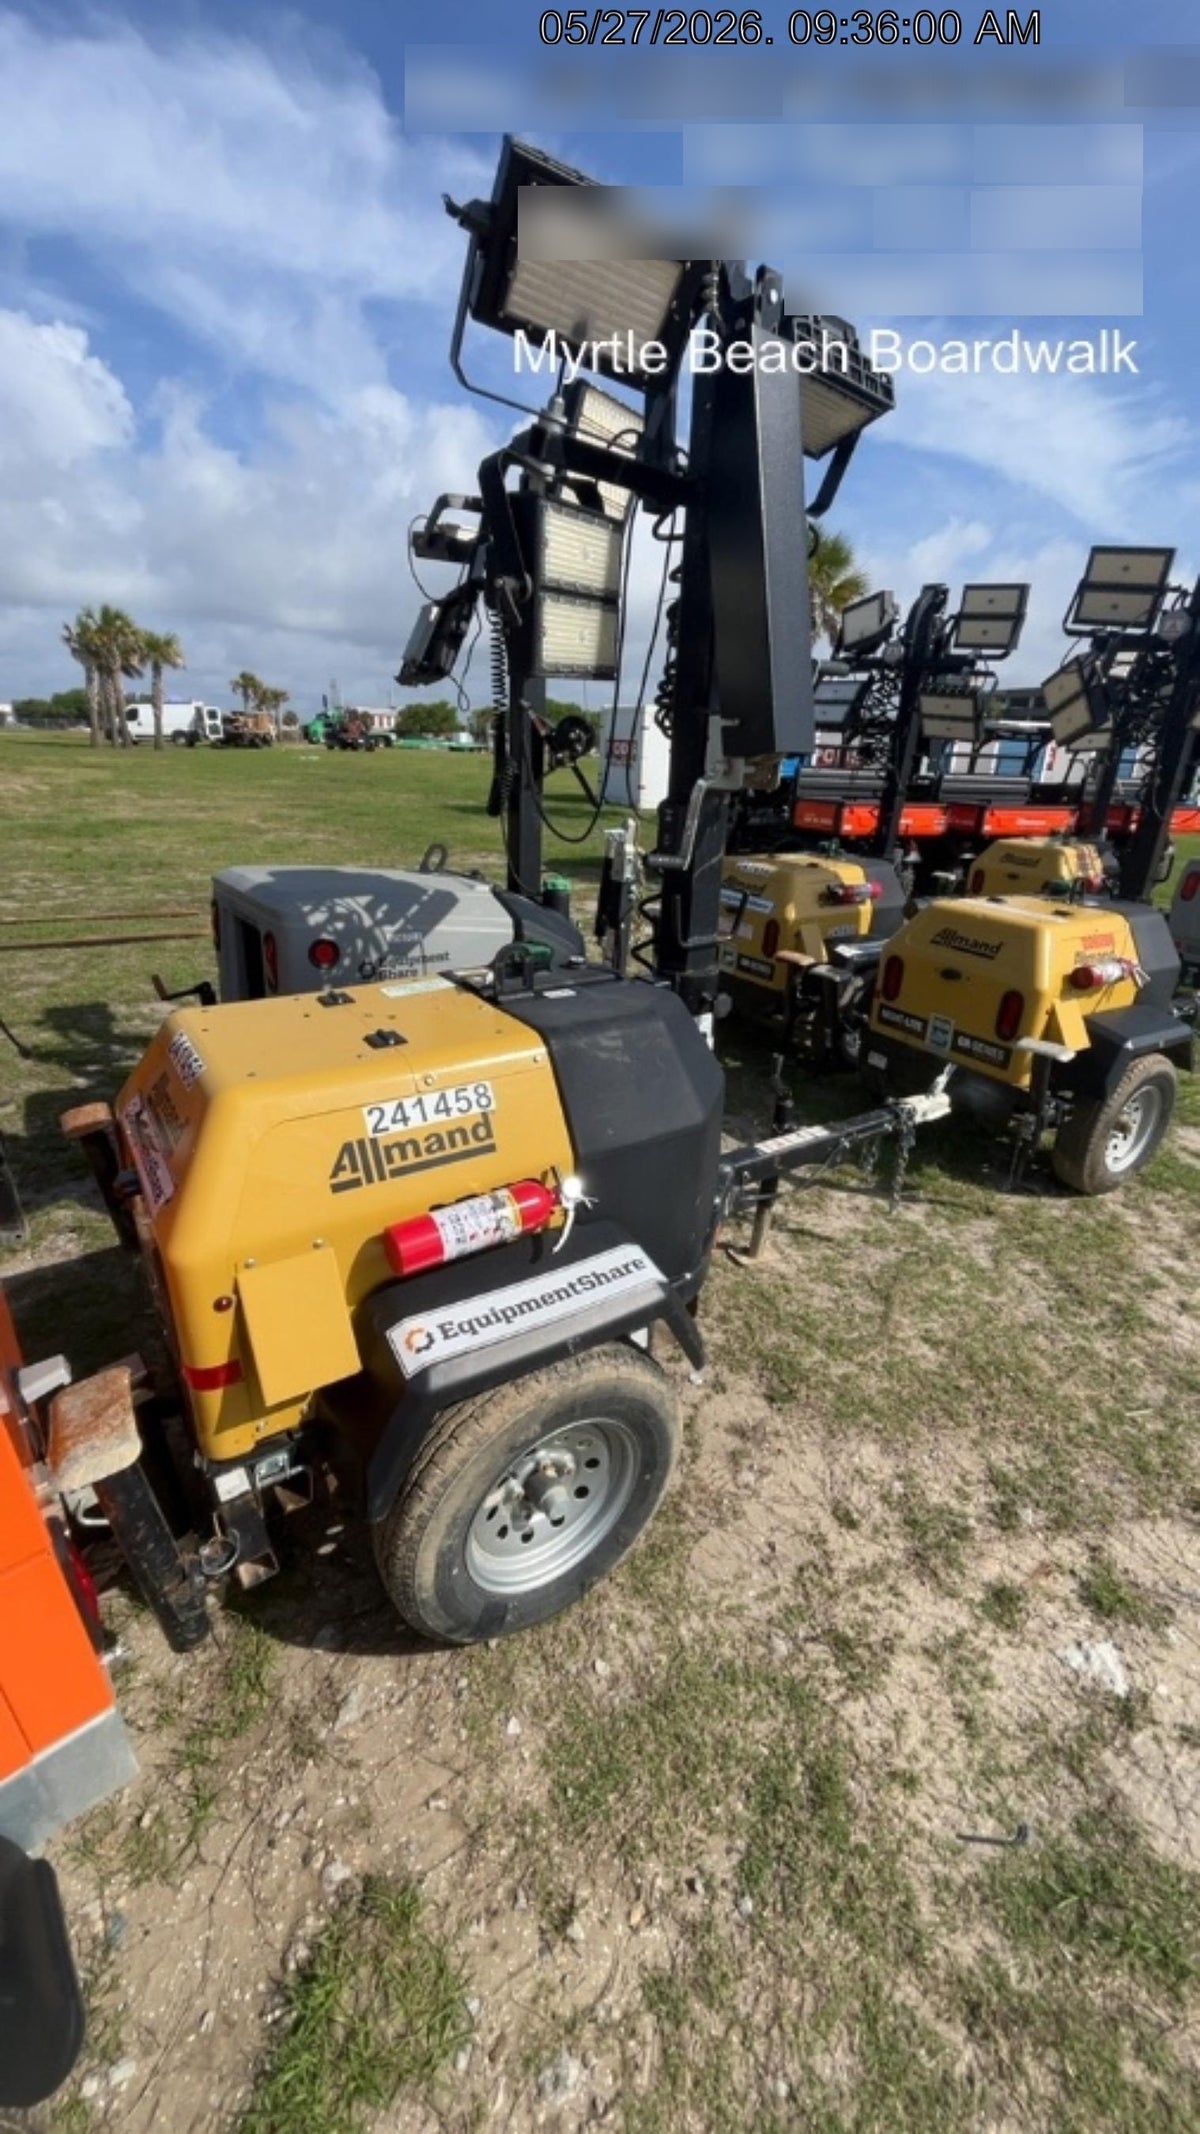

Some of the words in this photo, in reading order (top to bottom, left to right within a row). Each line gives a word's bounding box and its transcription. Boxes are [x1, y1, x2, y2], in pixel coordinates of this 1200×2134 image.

[367, 1083, 492, 1134] 241458
[329, 1111, 494, 1184] Allmand
[436, 1257, 647, 1341] EquipmentShare
